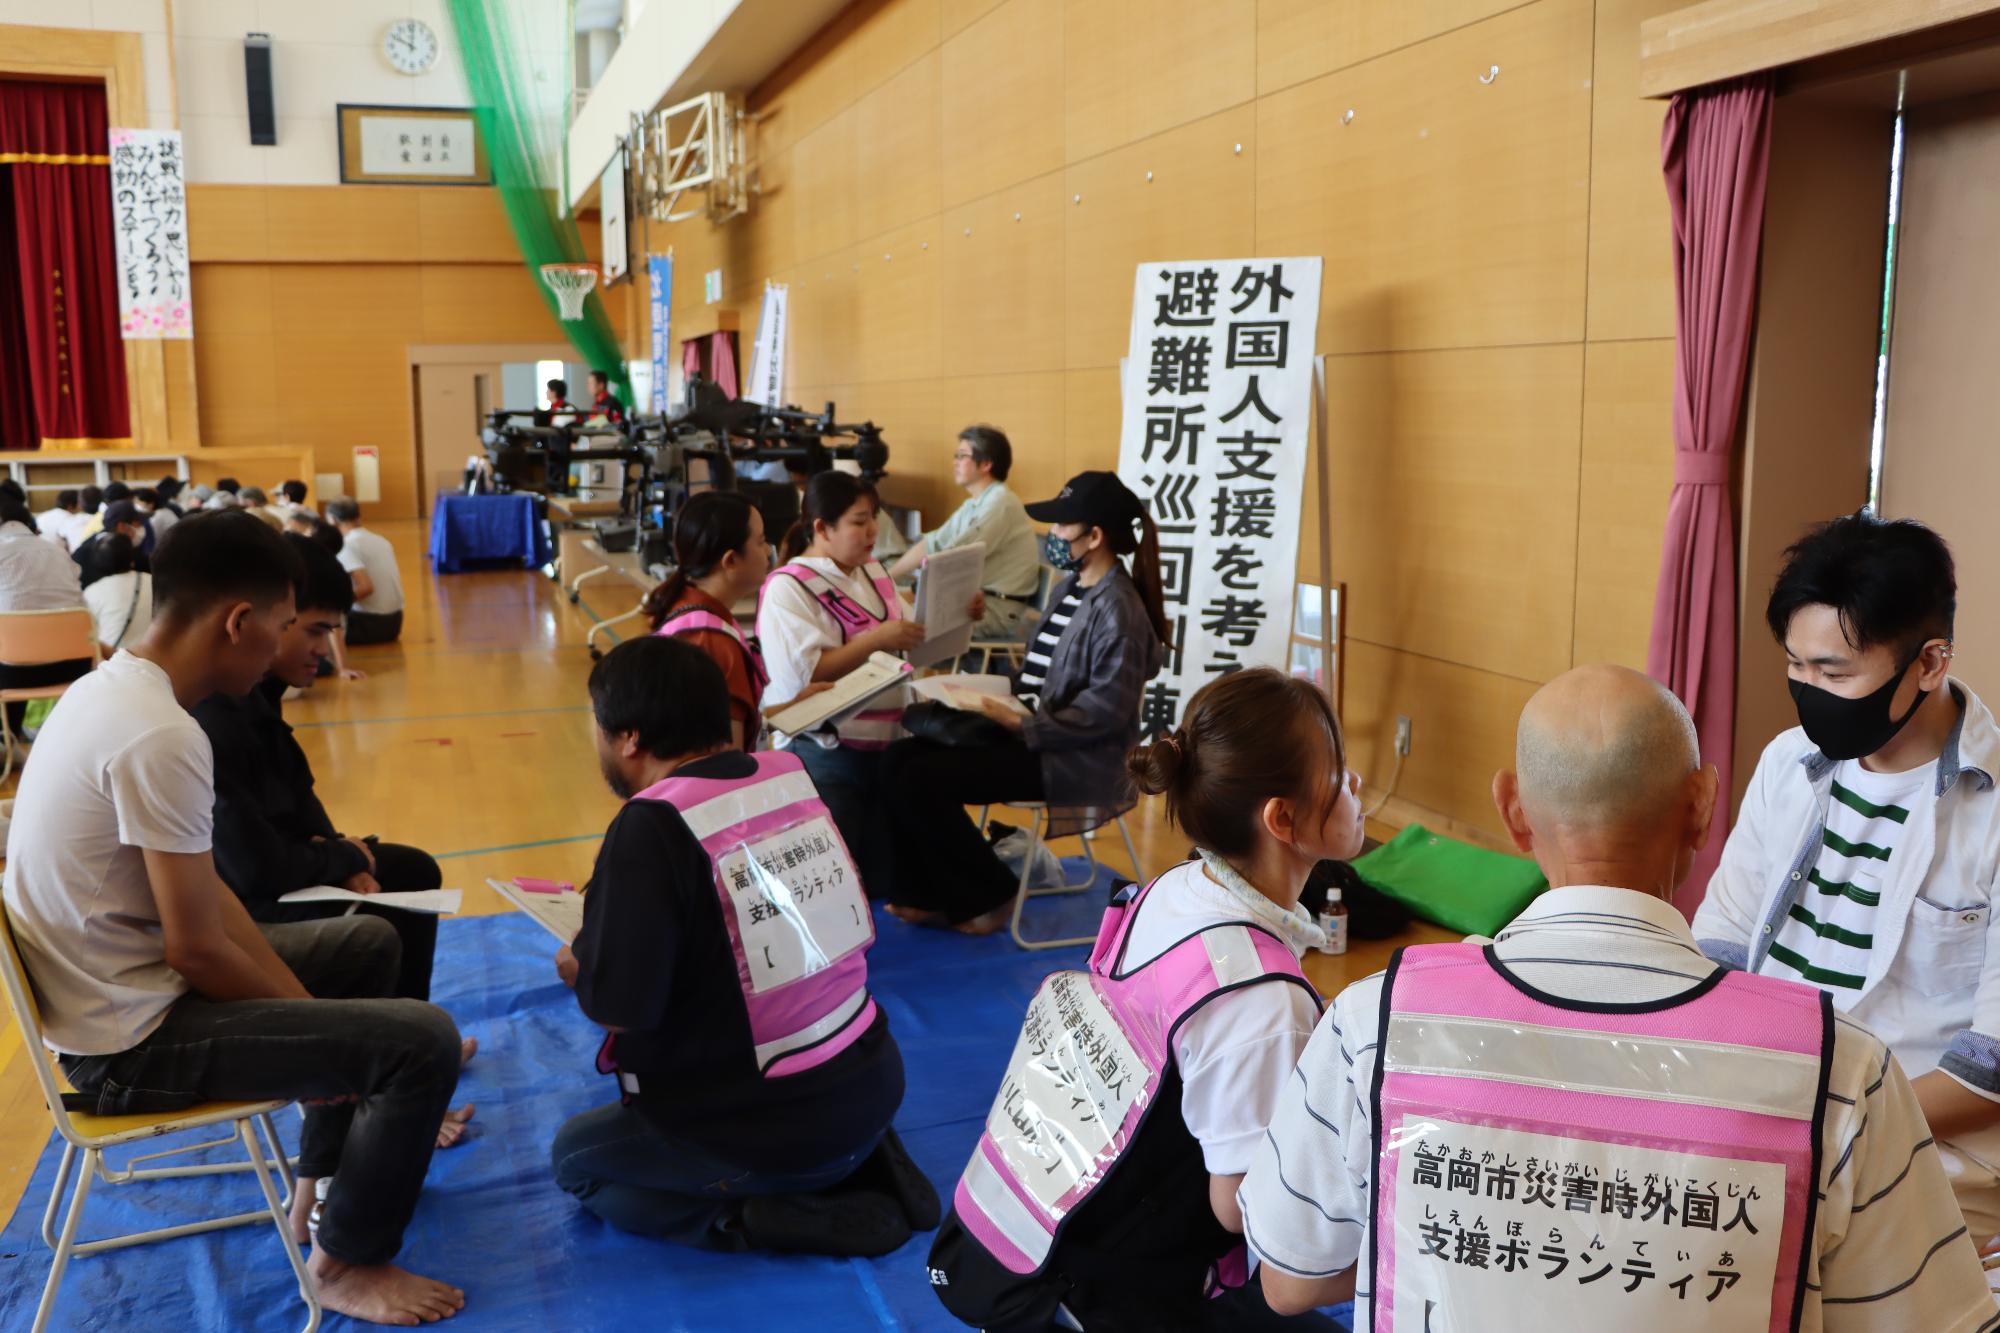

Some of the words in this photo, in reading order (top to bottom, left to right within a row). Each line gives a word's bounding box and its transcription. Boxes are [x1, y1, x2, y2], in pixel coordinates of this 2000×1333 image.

[730, 832, 835, 892] 高市災害時外国人
[1412, 1152, 1760, 1236] 高岡市災害時外国人
[1417, 1221, 1742, 1302] 支援ボランティア
